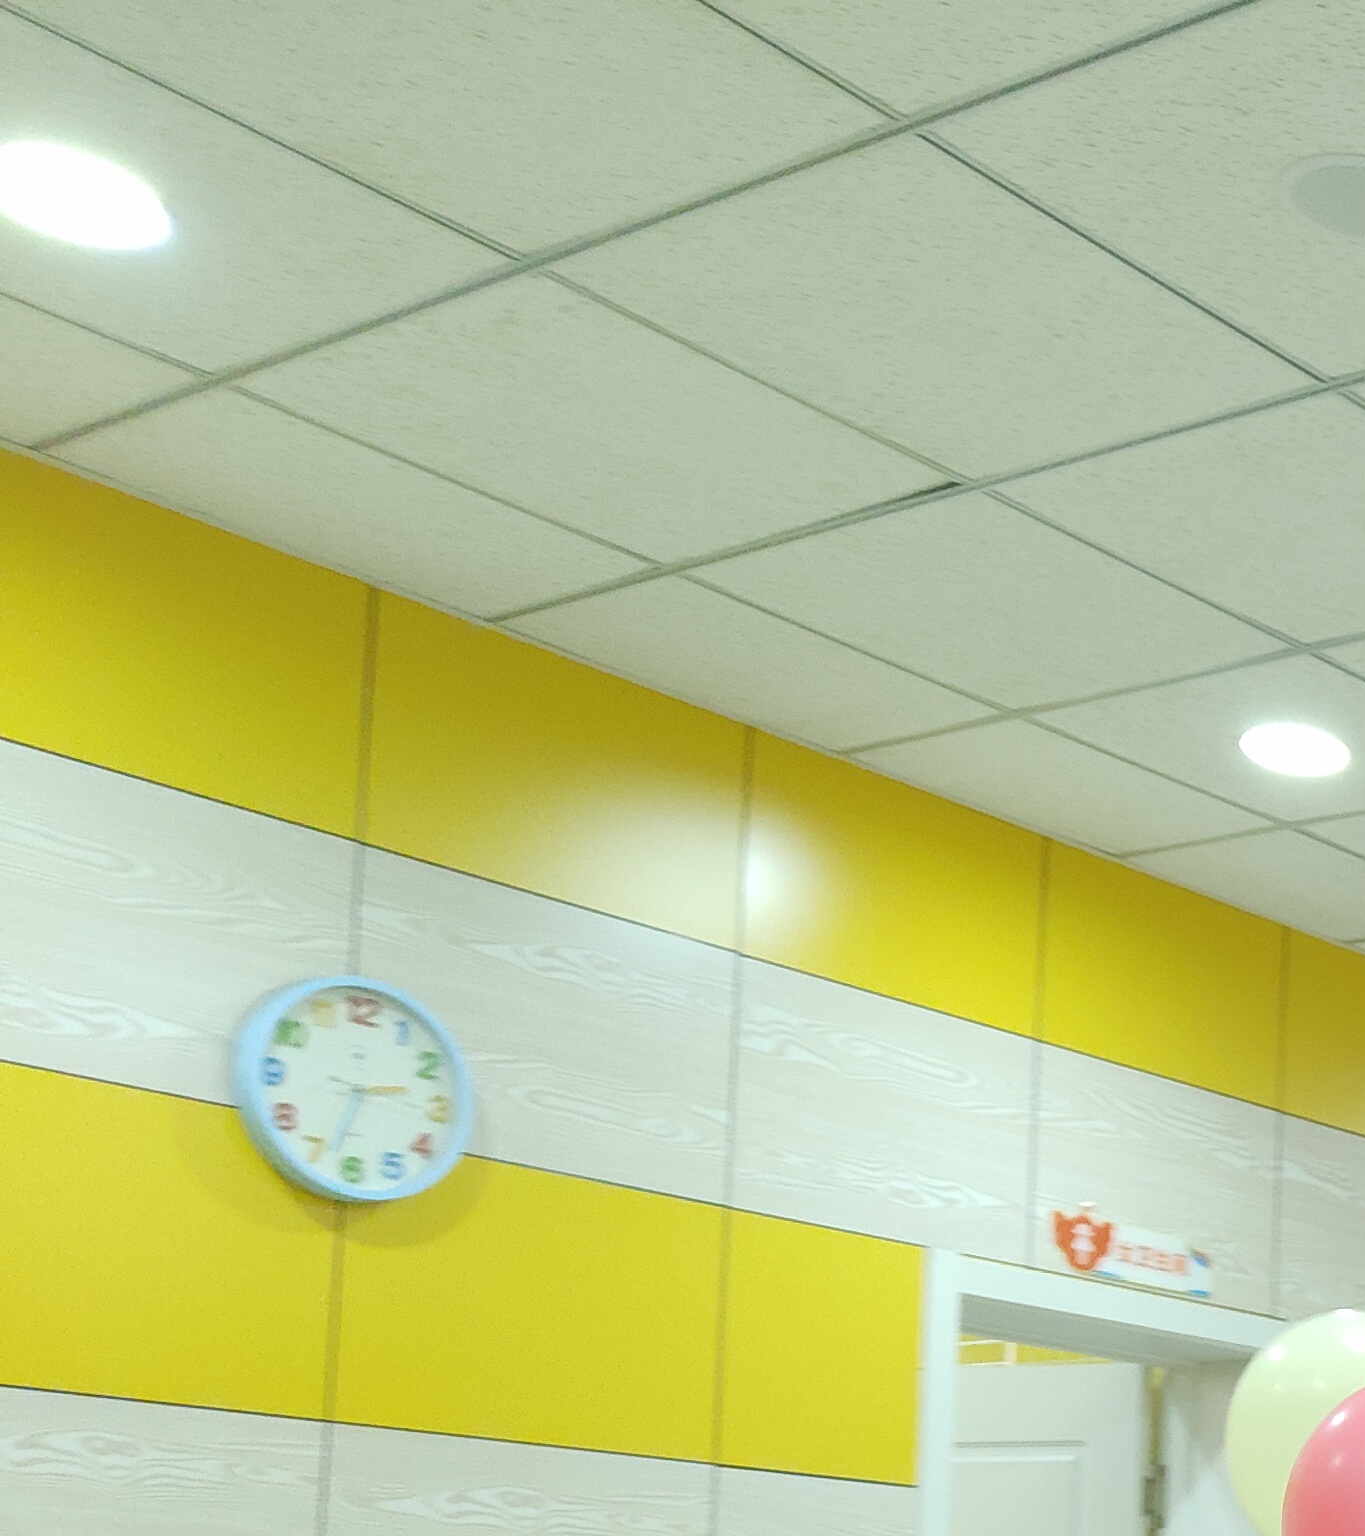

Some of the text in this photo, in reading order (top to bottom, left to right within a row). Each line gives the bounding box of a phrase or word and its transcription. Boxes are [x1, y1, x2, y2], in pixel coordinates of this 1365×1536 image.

[345, 996, 383, 1028] 12
[415, 1052, 440, 1080] 2
[427, 1094, 450, 1124] 3
[302, 1135, 326, 1163] 7
[410, 1131, 434, 1159] 4
[339, 1155, 364, 1184] 6
[379, 1151, 406, 1180] 5
